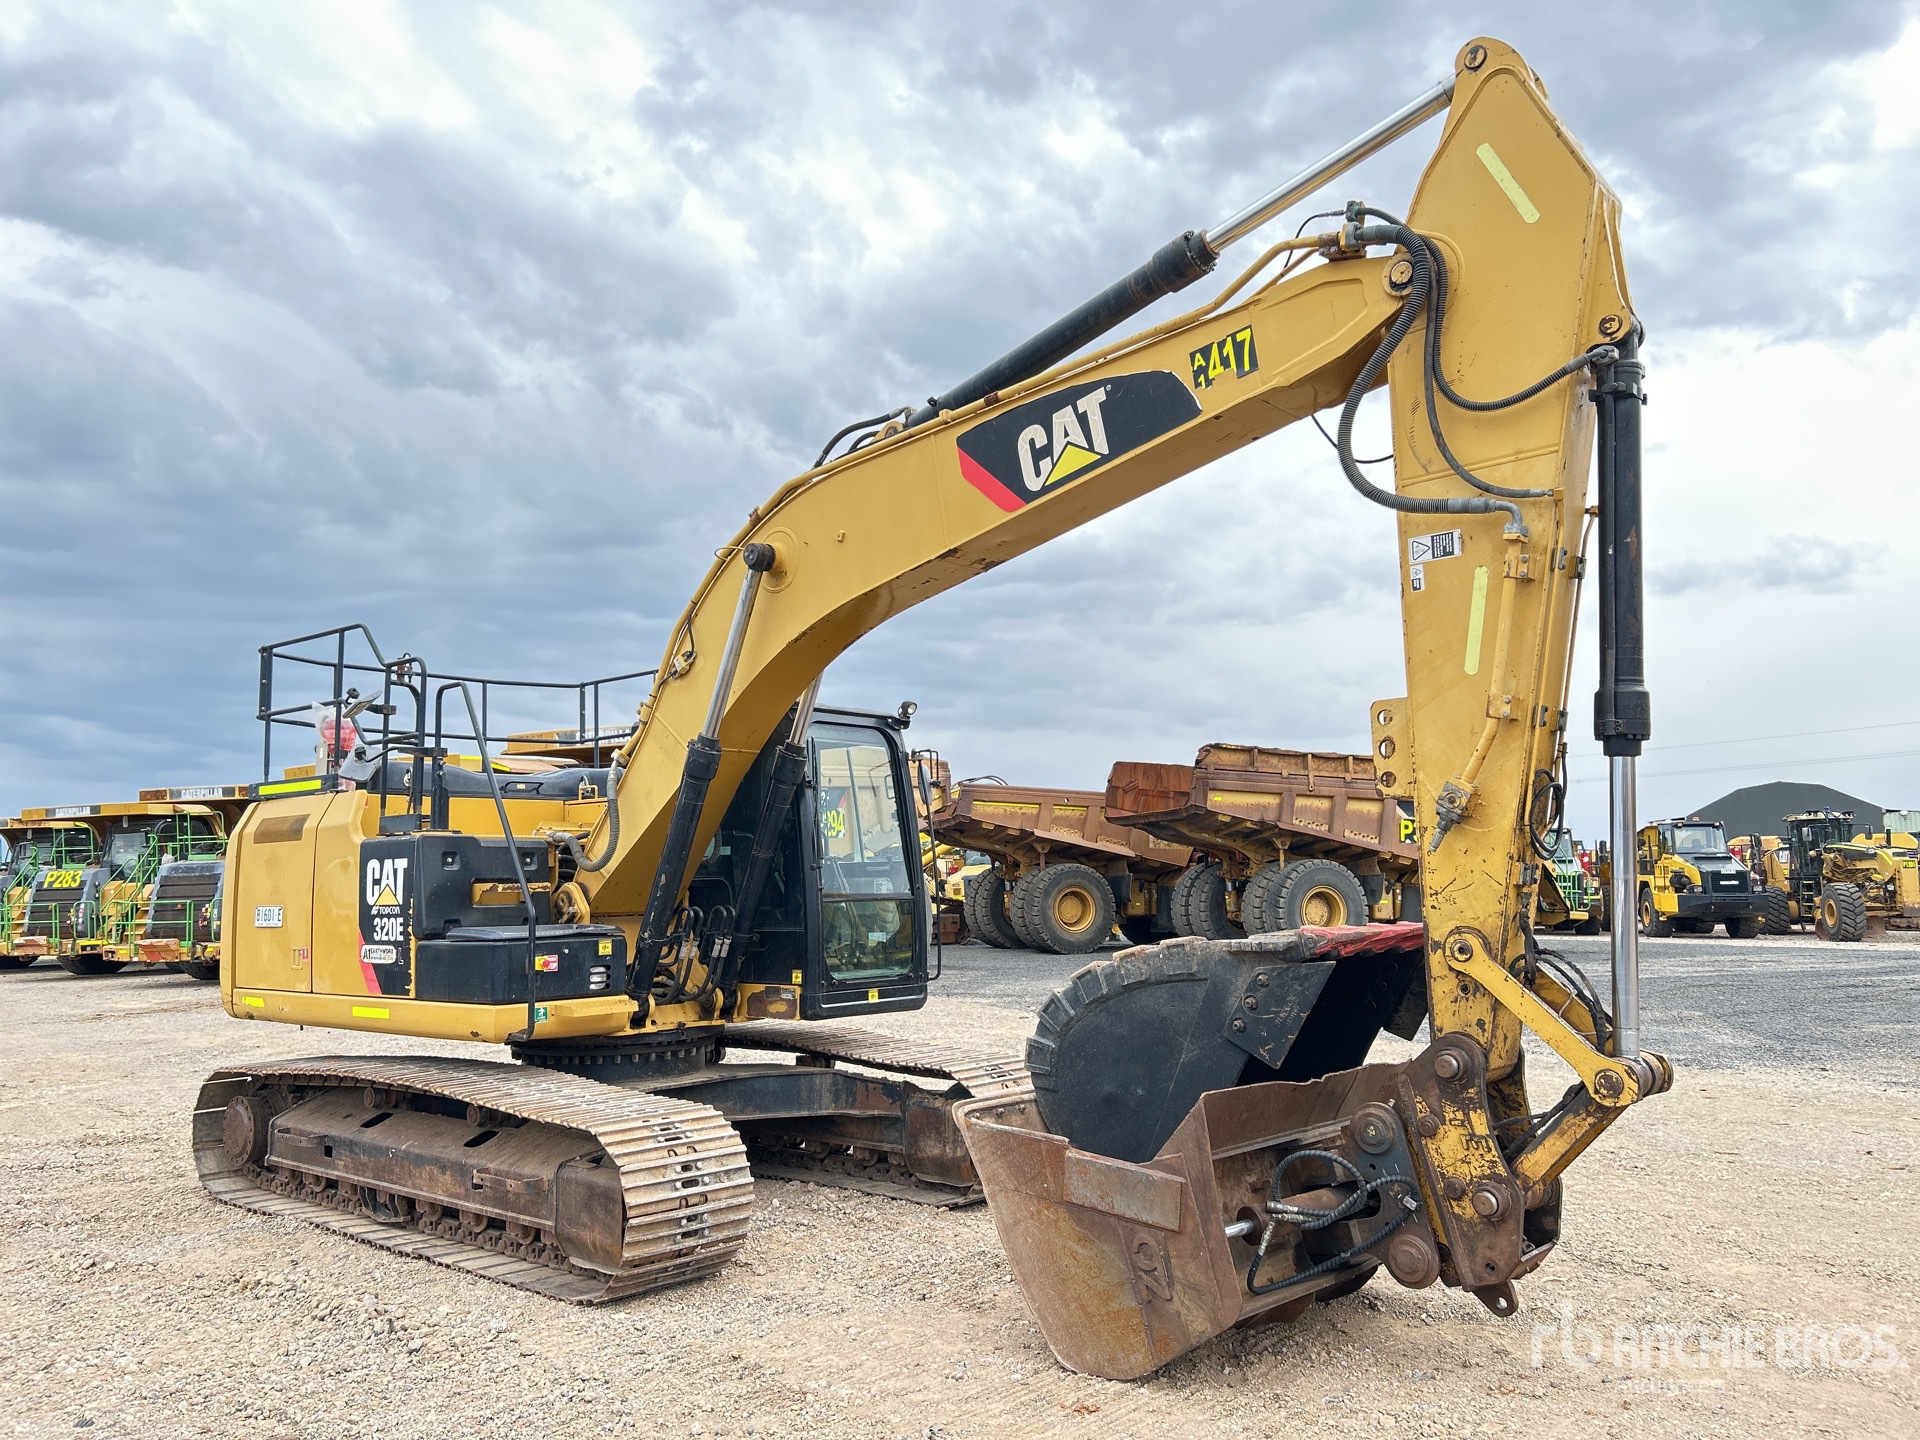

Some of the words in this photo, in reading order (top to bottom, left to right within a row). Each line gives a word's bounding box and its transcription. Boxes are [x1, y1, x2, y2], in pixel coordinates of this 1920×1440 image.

[1193, 352, 1206, 371] A
[1208, 327, 1252, 380] 417
[1016, 386, 1110, 492] CAT
[181, 788, 223, 800] CATERPILLAR
[55, 806, 91, 818] CATERPILLAR
[43, 870, 84, 889] P283
[366, 857, 408, 906] CAT
[379, 906, 401, 915] TOPCON
[373, 917, 404, 942] 320E
[363, 948, 371, 960] A1
